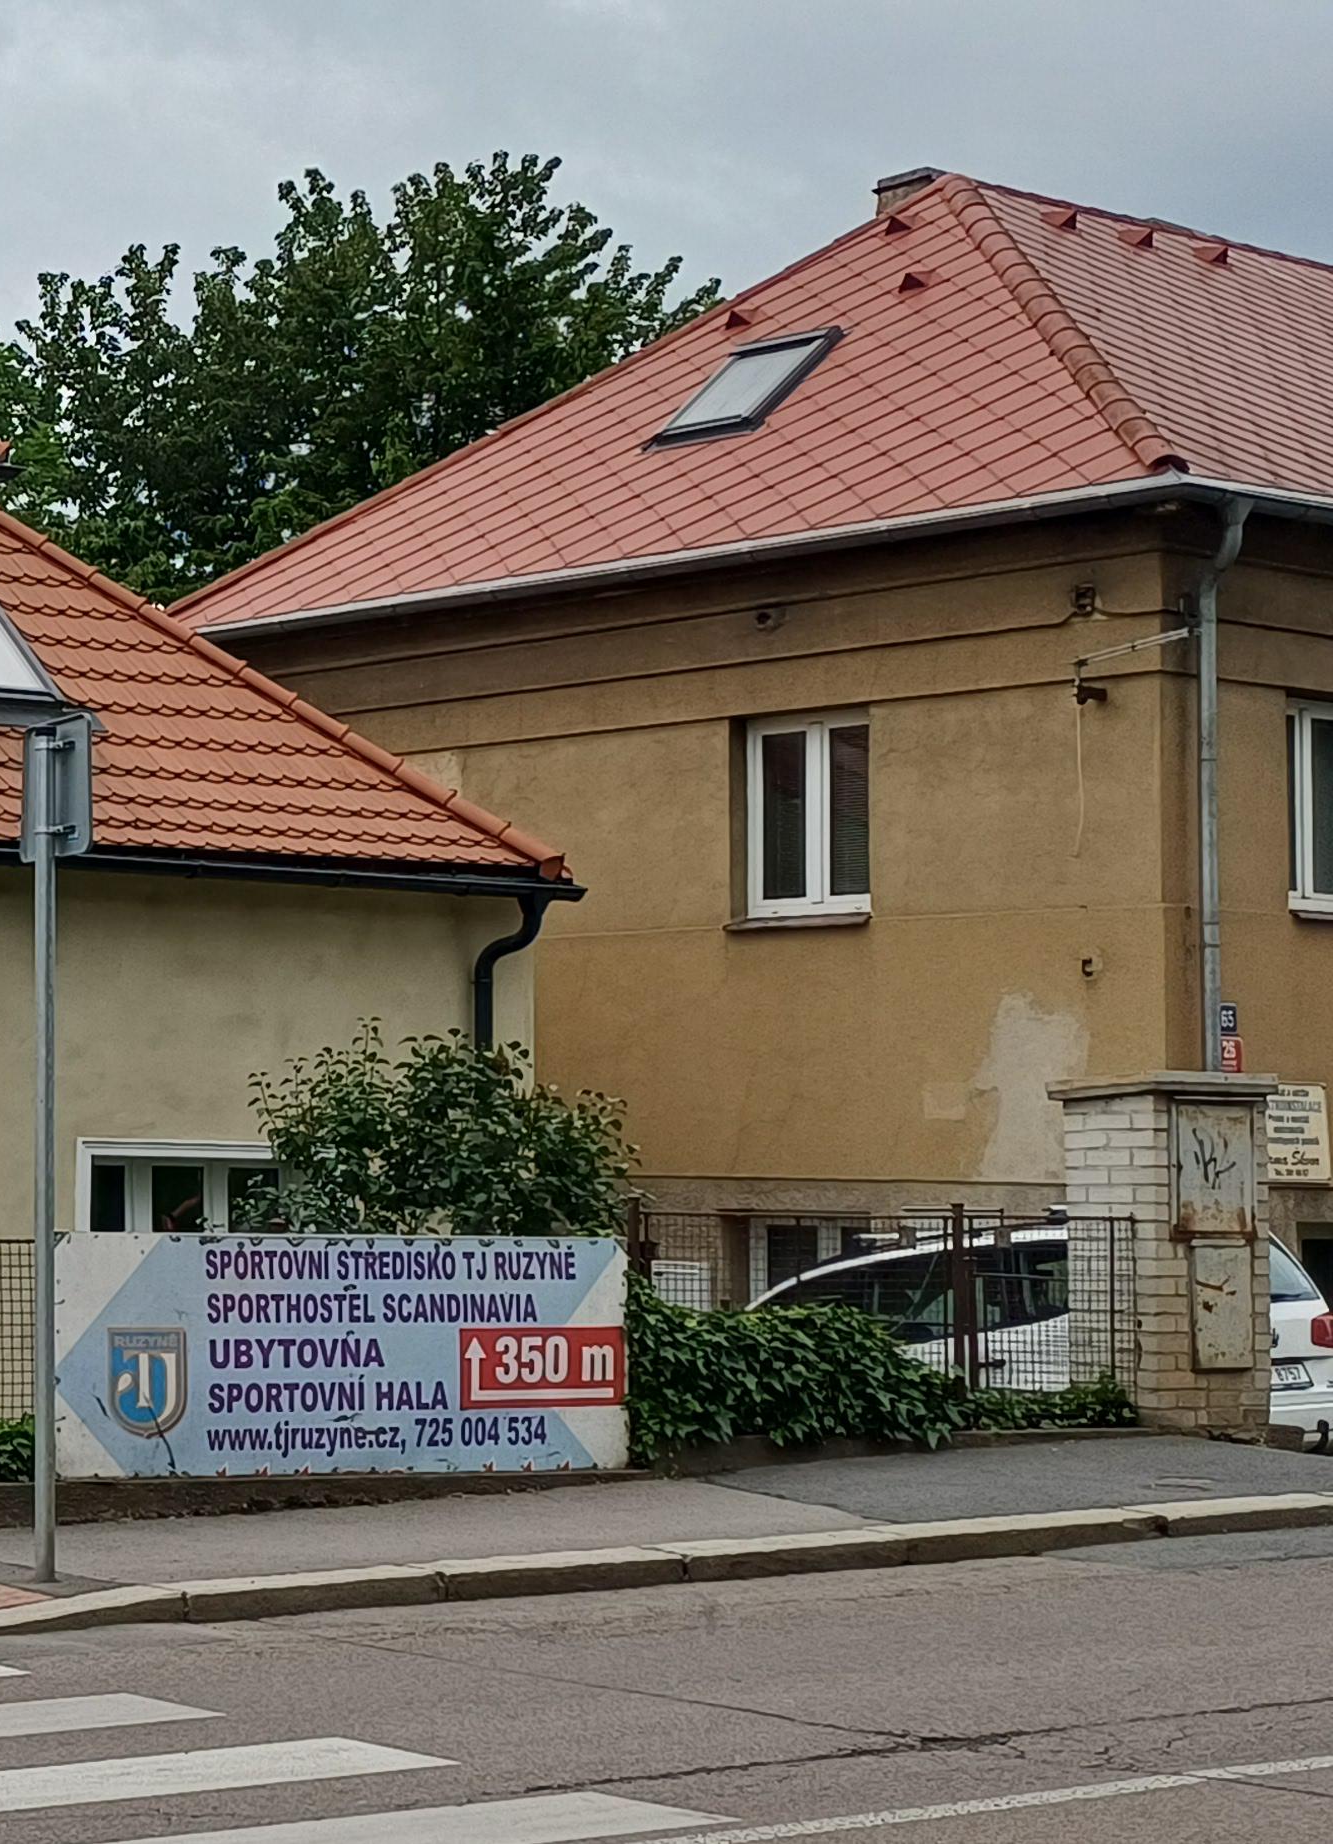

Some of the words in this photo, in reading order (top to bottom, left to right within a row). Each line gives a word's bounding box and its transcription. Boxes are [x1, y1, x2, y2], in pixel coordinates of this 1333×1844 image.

[463, 1250, 487, 1281] TJ
[494, 1245, 576, 1281] RUZYNĚ
[207, 1292, 376, 1324] SPORTHOSTEL
[382, 1292, 538, 1324] SCANDINAVIA
[494, 1335, 569, 1384] 350
[581, 1344, 614, 1382] m
[208, 1374, 365, 1413] SPORTOVNÍ
[375, 1380, 449, 1411] HALA
[206, 1420, 407, 1458] www.tjruzyne.cz,
[414, 1417, 454, 1448] 725
[460, 1416, 500, 1447] 004
[507, 1415, 547, 1446] 534
